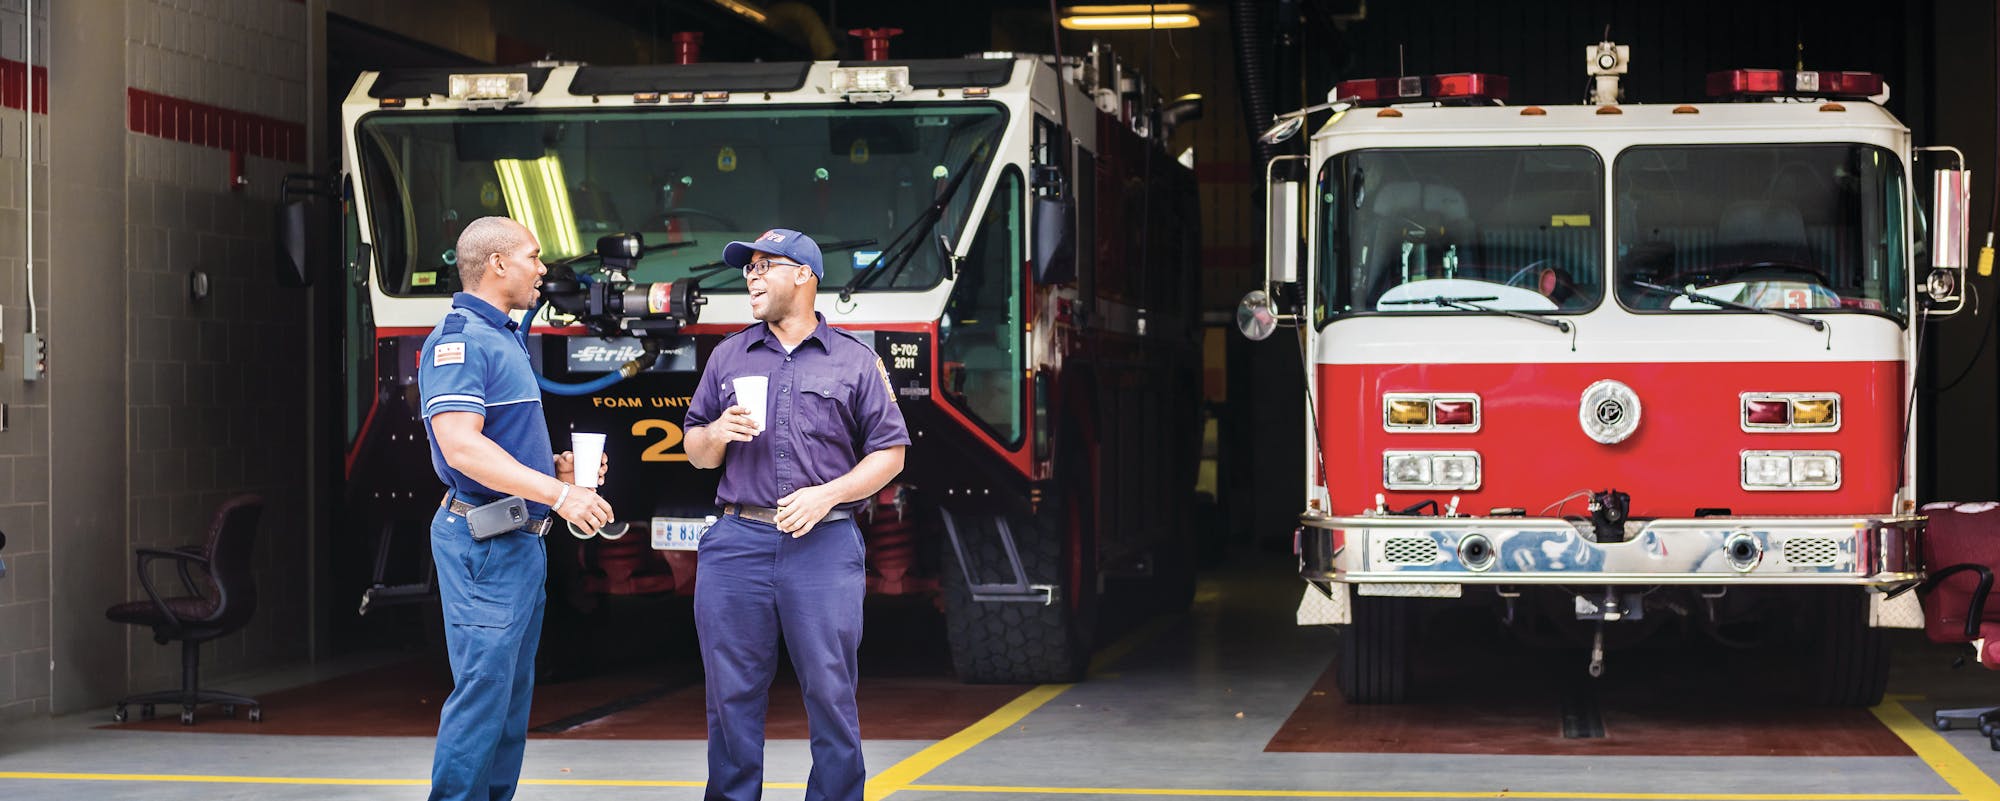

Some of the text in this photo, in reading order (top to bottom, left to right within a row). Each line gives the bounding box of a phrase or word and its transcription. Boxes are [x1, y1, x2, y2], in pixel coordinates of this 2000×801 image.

[1788, 291, 1807, 309] 3
[571, 346, 646, 362] Strik
[890, 343, 918, 356] S-702
[894, 356, 915, 369] 2011
[592, 396, 692, 408] FOAM UNIT
[631, 418, 689, 462] 2
